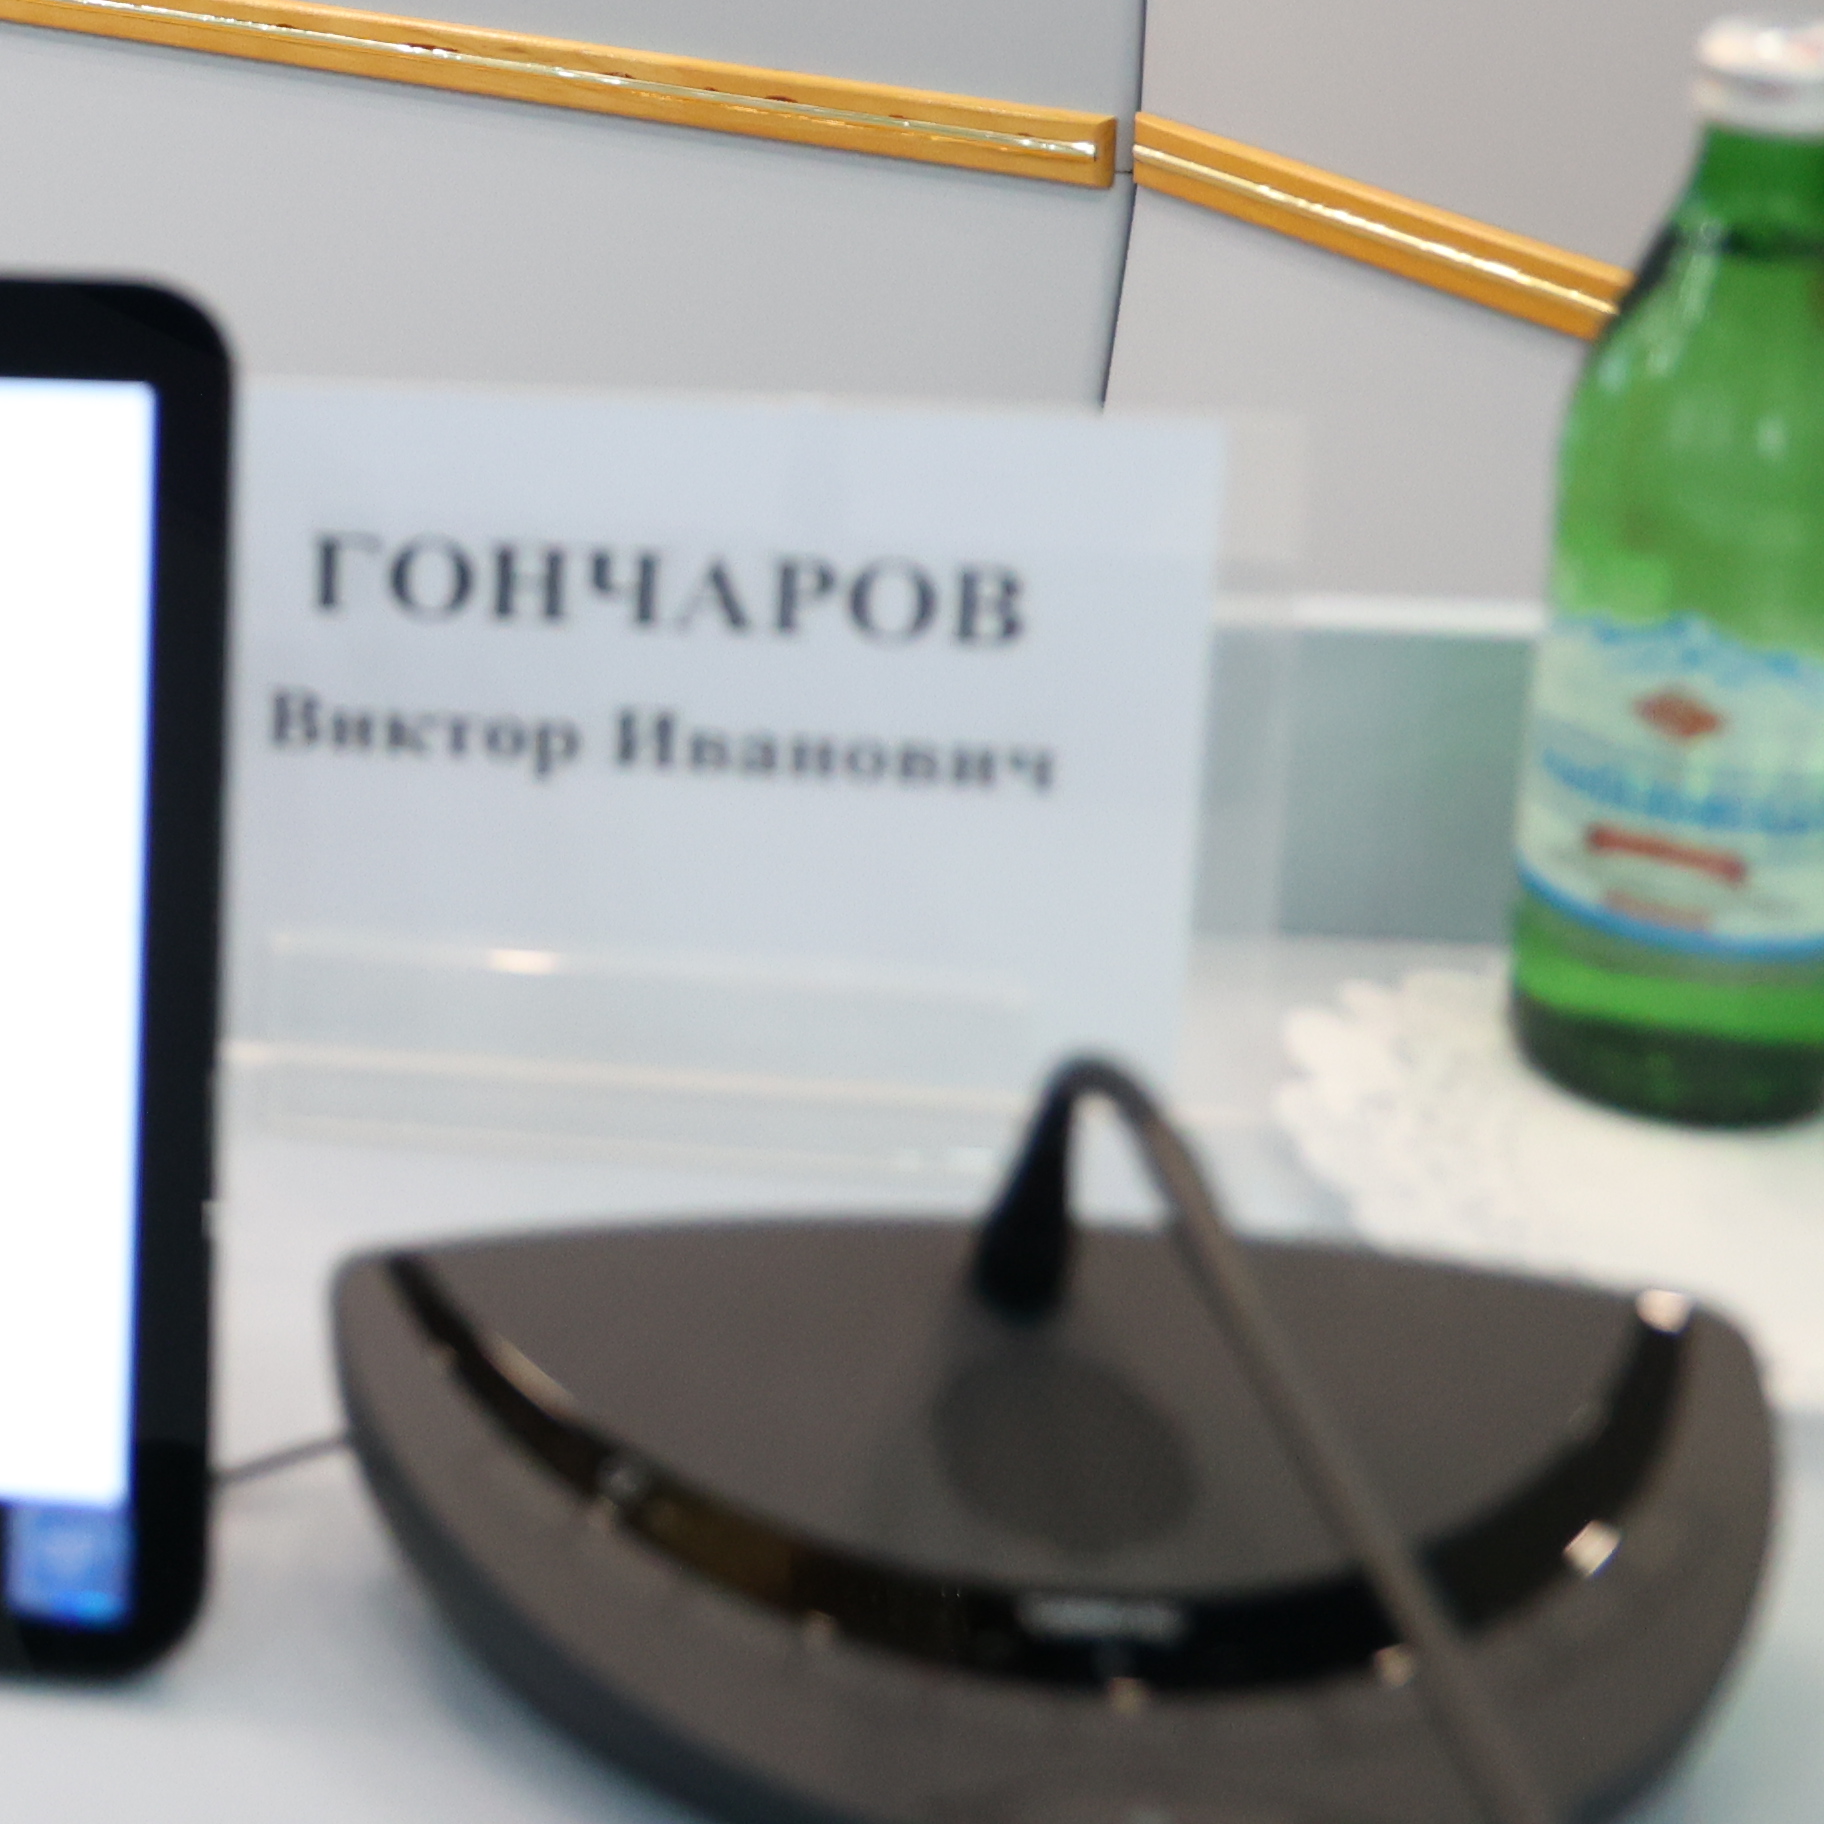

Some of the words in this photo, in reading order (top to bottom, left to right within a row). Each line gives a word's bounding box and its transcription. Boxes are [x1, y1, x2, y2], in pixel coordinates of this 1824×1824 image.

[312, 531, 1030, 648] ГОНЧАРОВ
[269, 684, 580, 780] Виктор
[614, 706, 1060, 798] Иванович
